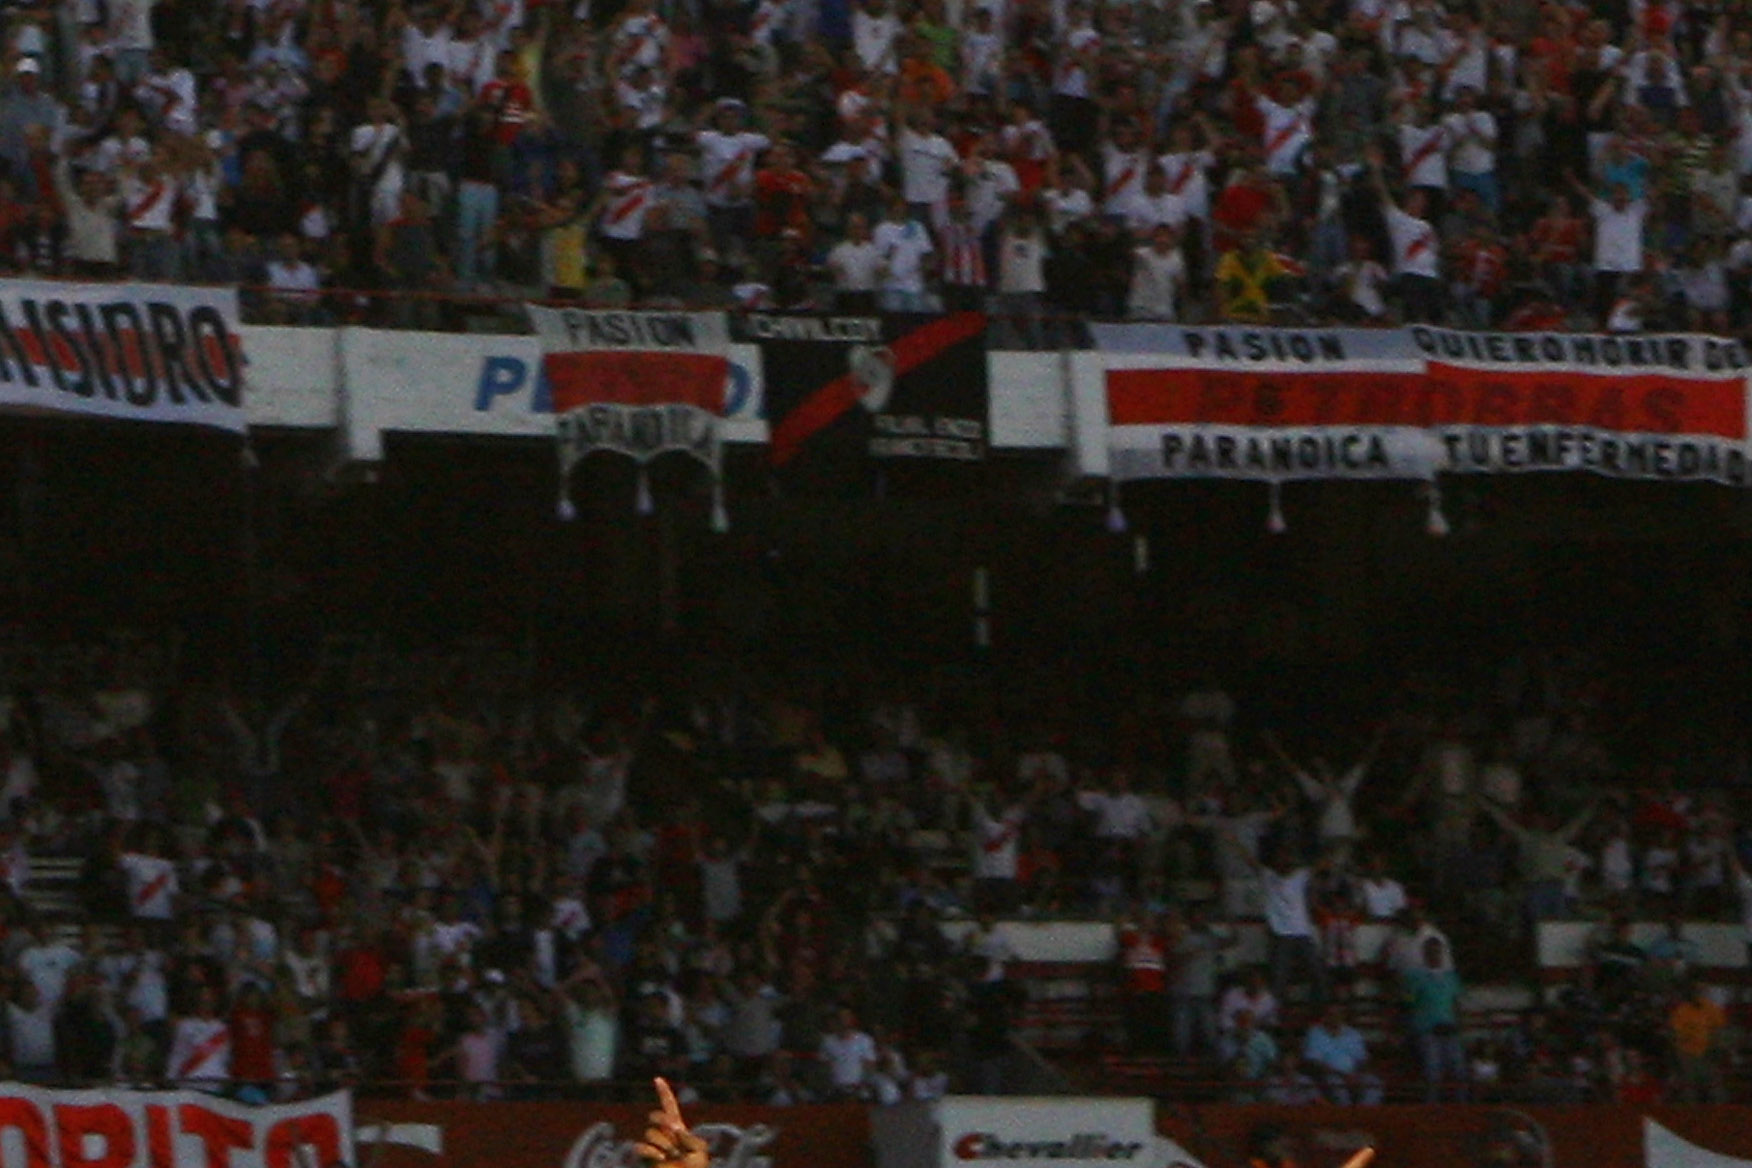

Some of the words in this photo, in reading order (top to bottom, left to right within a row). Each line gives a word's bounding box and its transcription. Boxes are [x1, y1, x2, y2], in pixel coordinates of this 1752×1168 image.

[1184, 332, 1346, 362] PASION
[1412, 326, 1566, 361] QUIERO
[1162, 434, 1389, 470] PARANOICA
